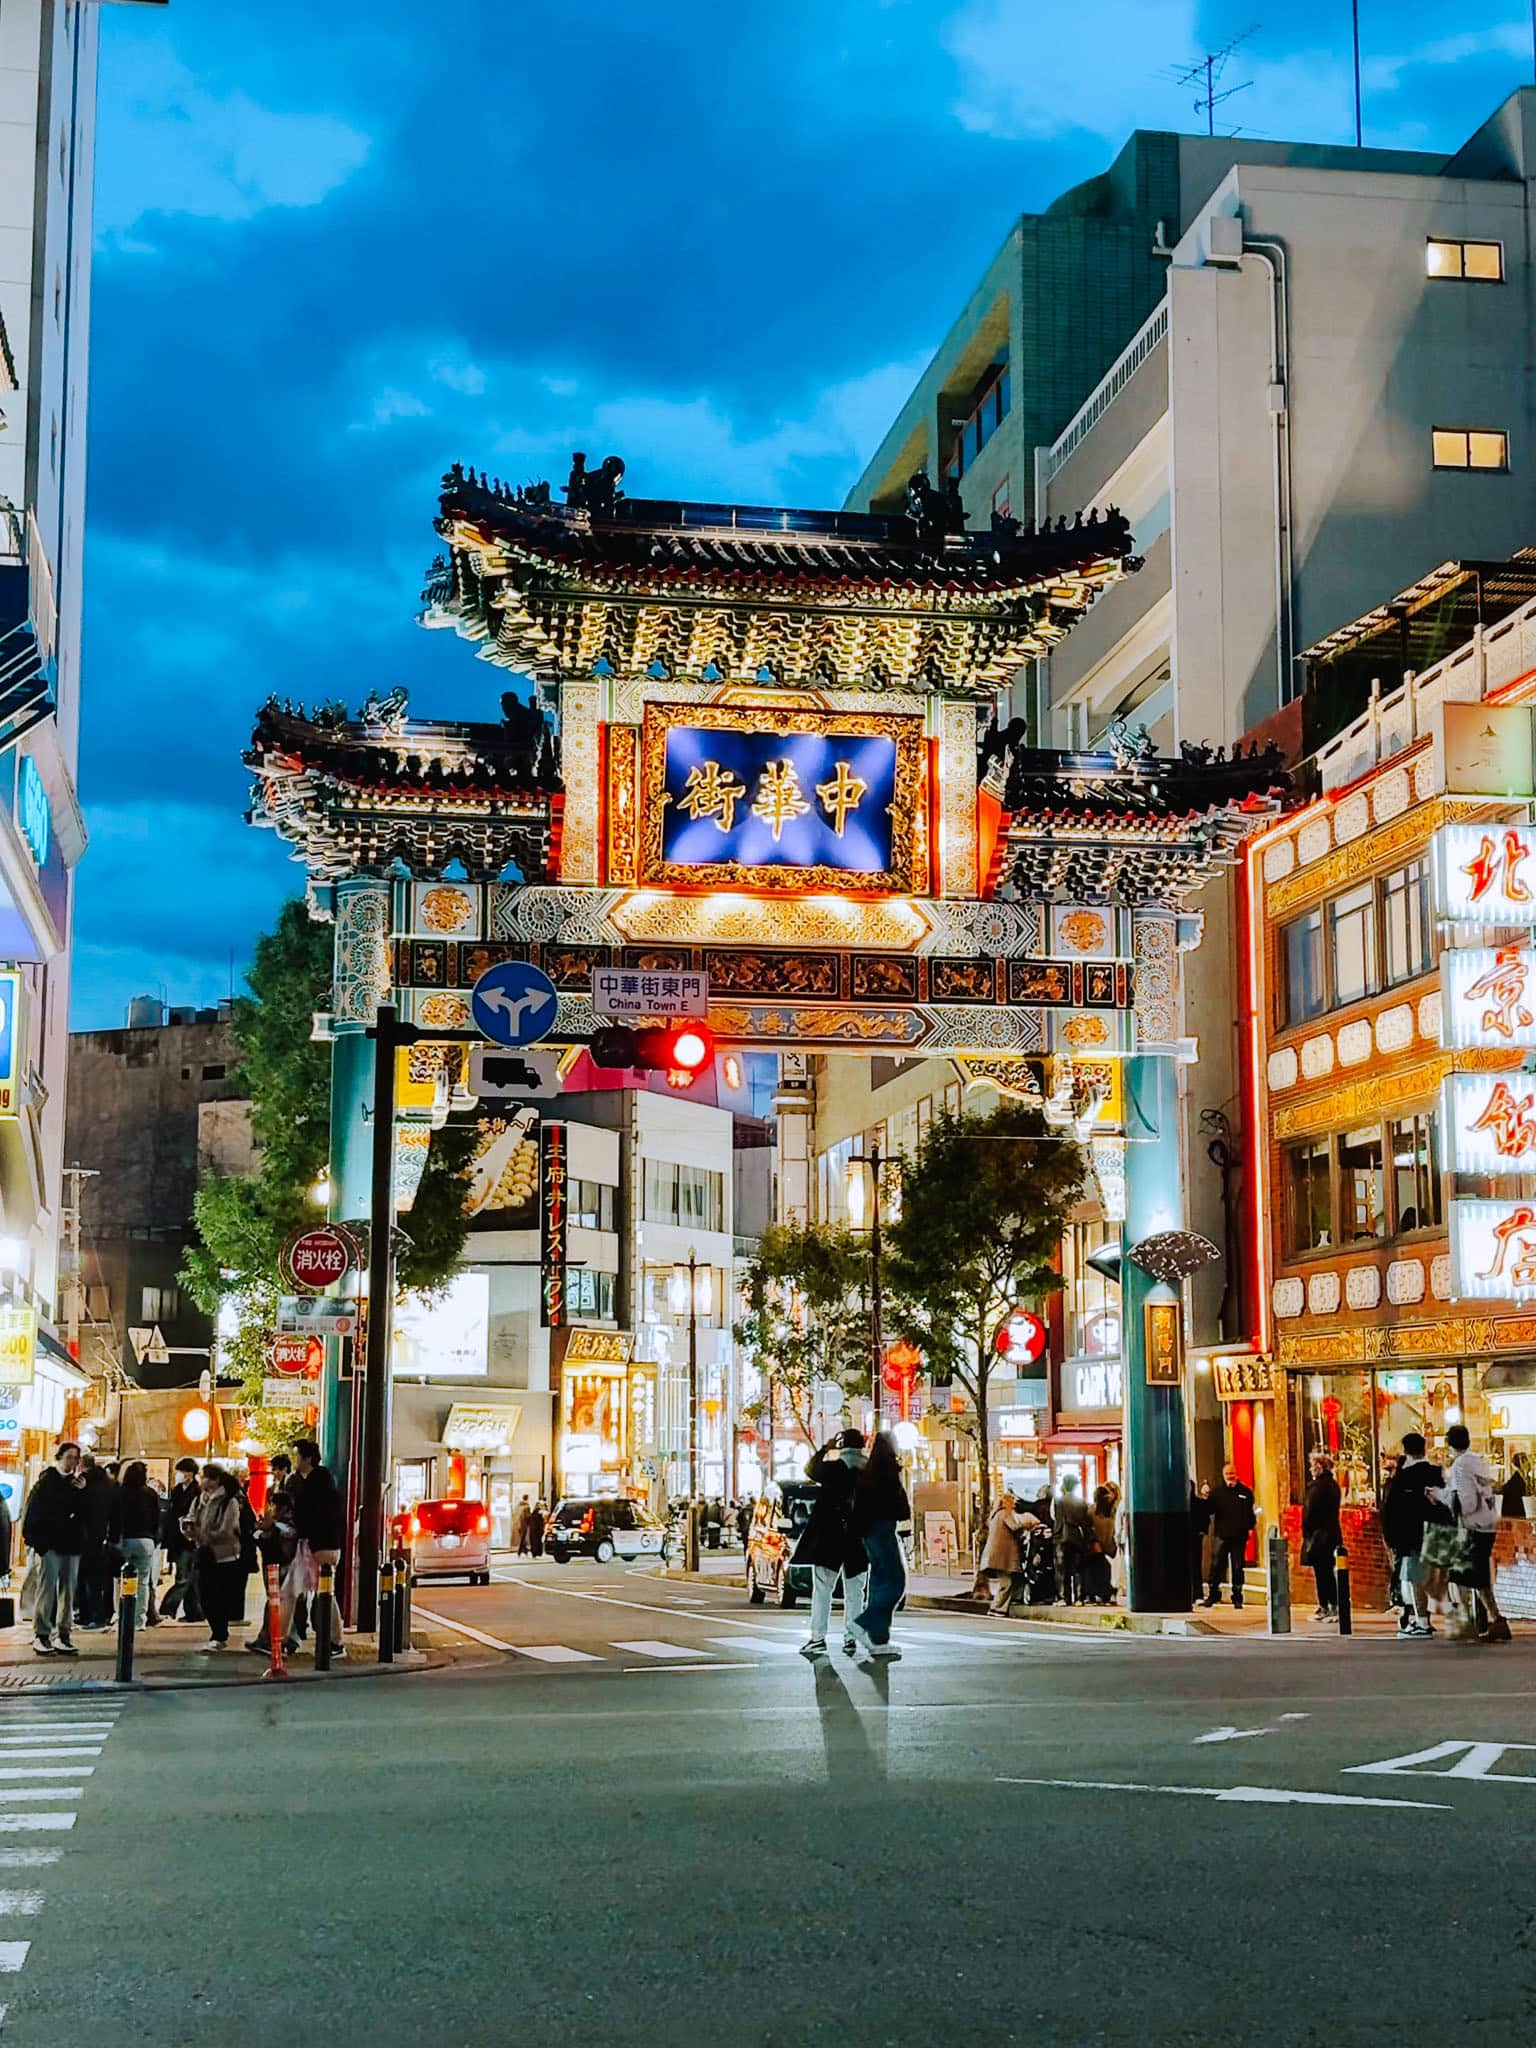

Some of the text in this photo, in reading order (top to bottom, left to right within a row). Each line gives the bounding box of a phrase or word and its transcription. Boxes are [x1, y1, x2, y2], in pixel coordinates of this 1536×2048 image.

[600, 975, 700, 998] 中華街東門
[608, 998, 689, 1012] China Town E
[296, 1249, 343, 1270] 消火栓
